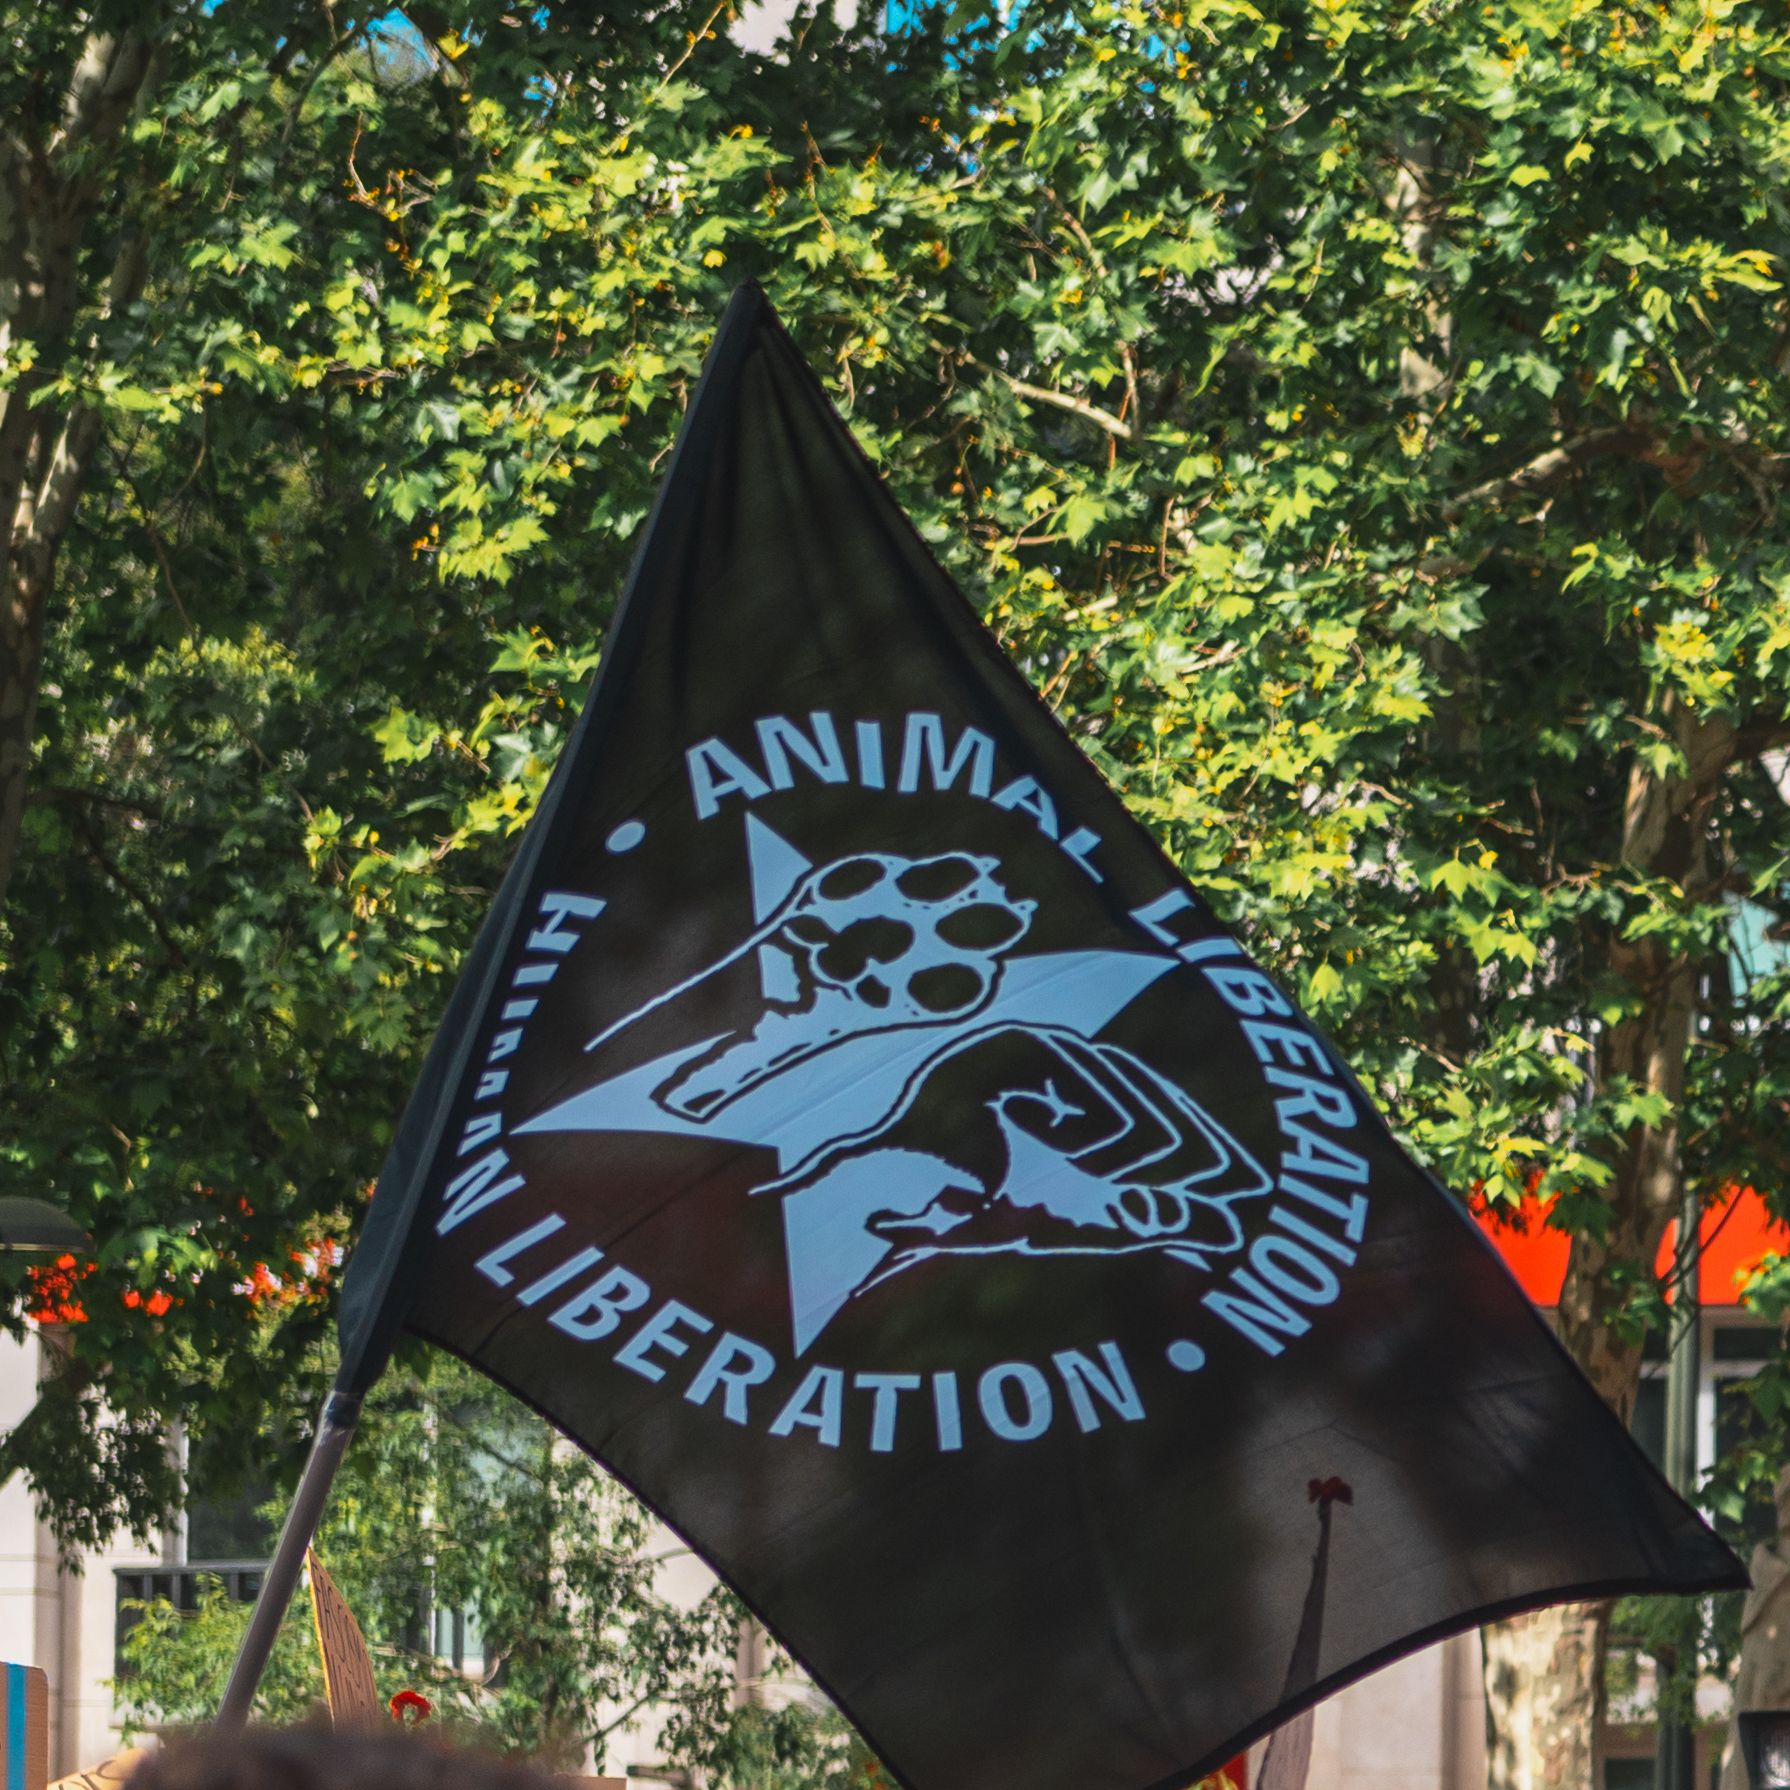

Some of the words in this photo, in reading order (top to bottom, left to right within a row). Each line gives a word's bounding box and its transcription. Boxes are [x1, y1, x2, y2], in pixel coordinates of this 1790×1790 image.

[686, 710, 1107, 885] ANIMAL
[1131, 888, 1370, 1356] LIBERATION
[474, 1212, 1146, 1453] LIBERATION
